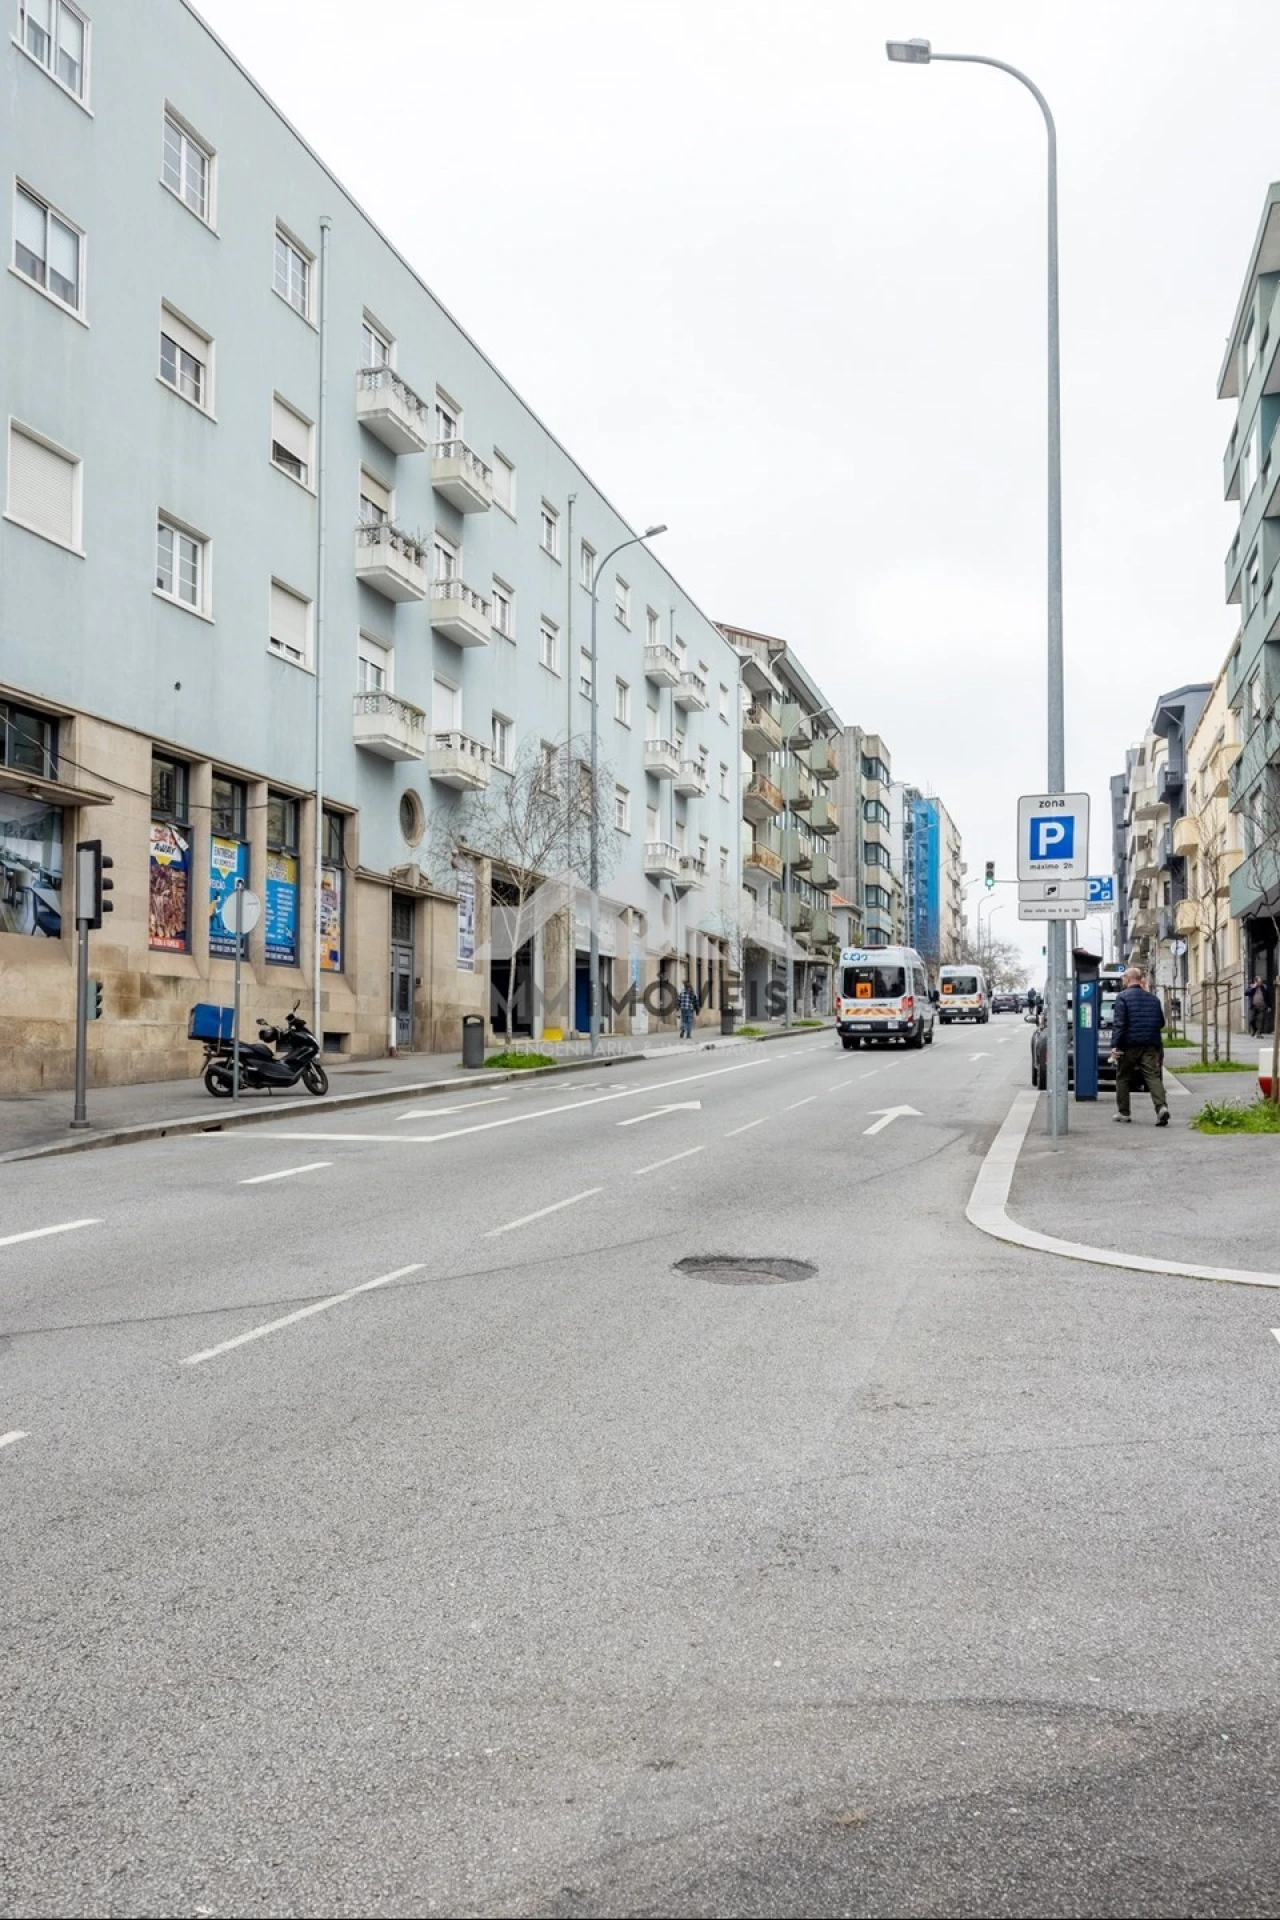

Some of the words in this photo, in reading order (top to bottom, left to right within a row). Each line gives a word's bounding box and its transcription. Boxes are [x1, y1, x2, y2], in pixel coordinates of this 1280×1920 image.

[1038, 799, 1066, 809] zona
[1038, 821, 1066, 857] P
[1029, 862, 1060, 870] máximo
[1087, 880, 1101, 901] P
[1080, 983, 1090, 997] P
